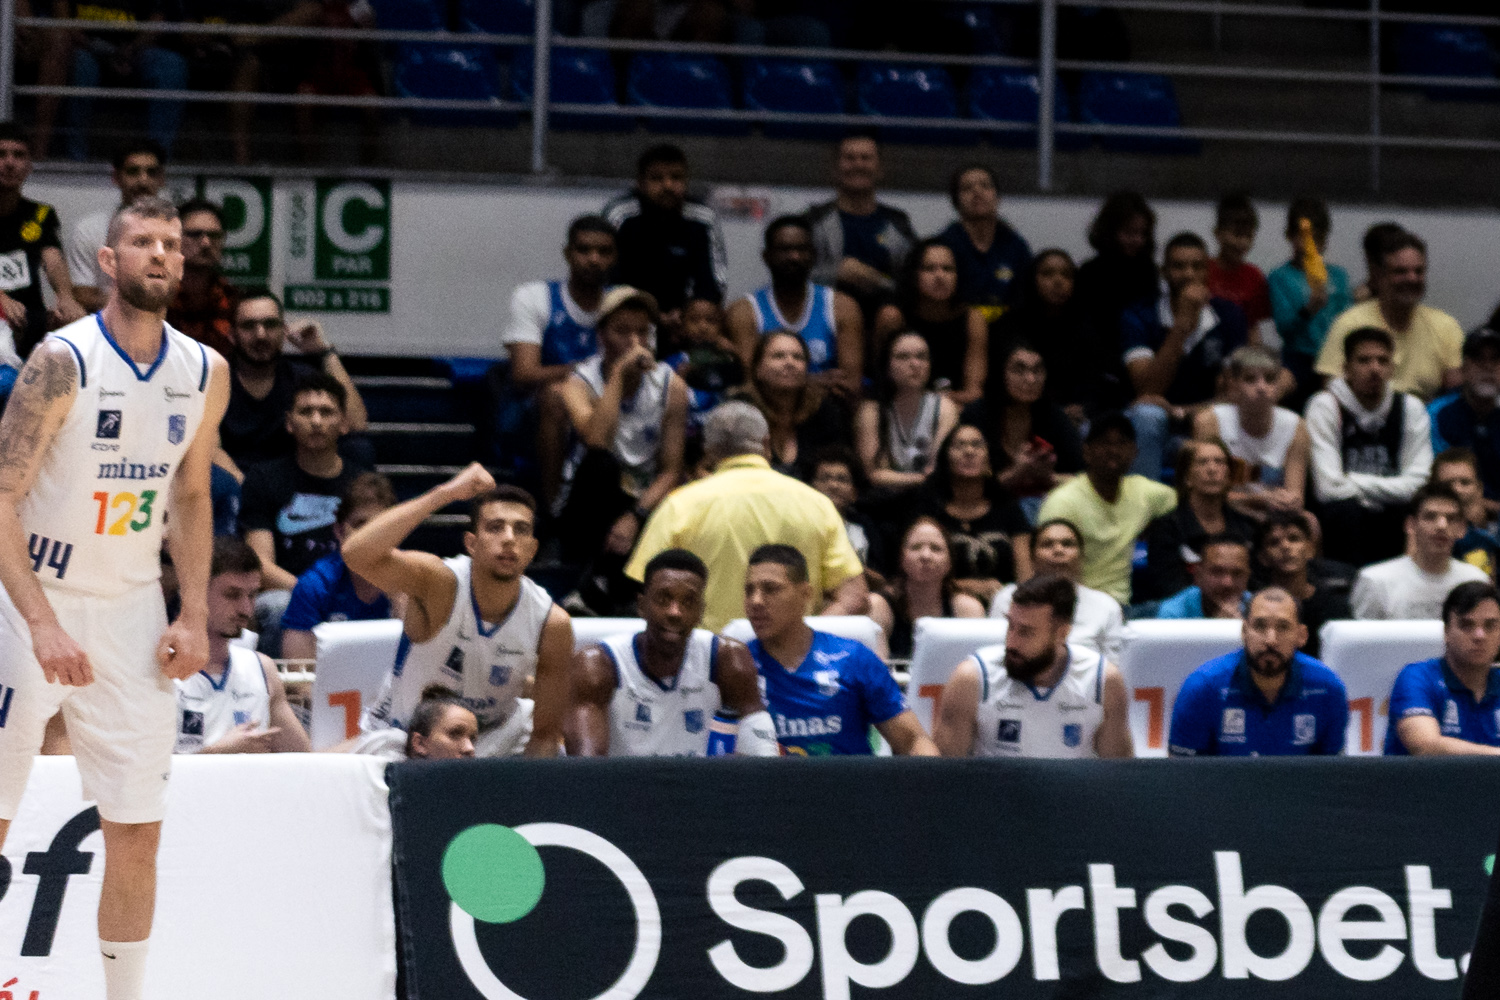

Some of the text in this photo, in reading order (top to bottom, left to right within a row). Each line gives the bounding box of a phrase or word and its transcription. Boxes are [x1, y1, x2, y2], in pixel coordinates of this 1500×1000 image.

[322, 181, 385, 252] C
[221, 254, 250, 271] AR
[332, 254, 373, 273] PAR
[93, 490, 157, 536] 123
[28, 533, 74, 580] 44
[774, 713, 843, 738] inas
[1133, 687, 1165, 749] 1
